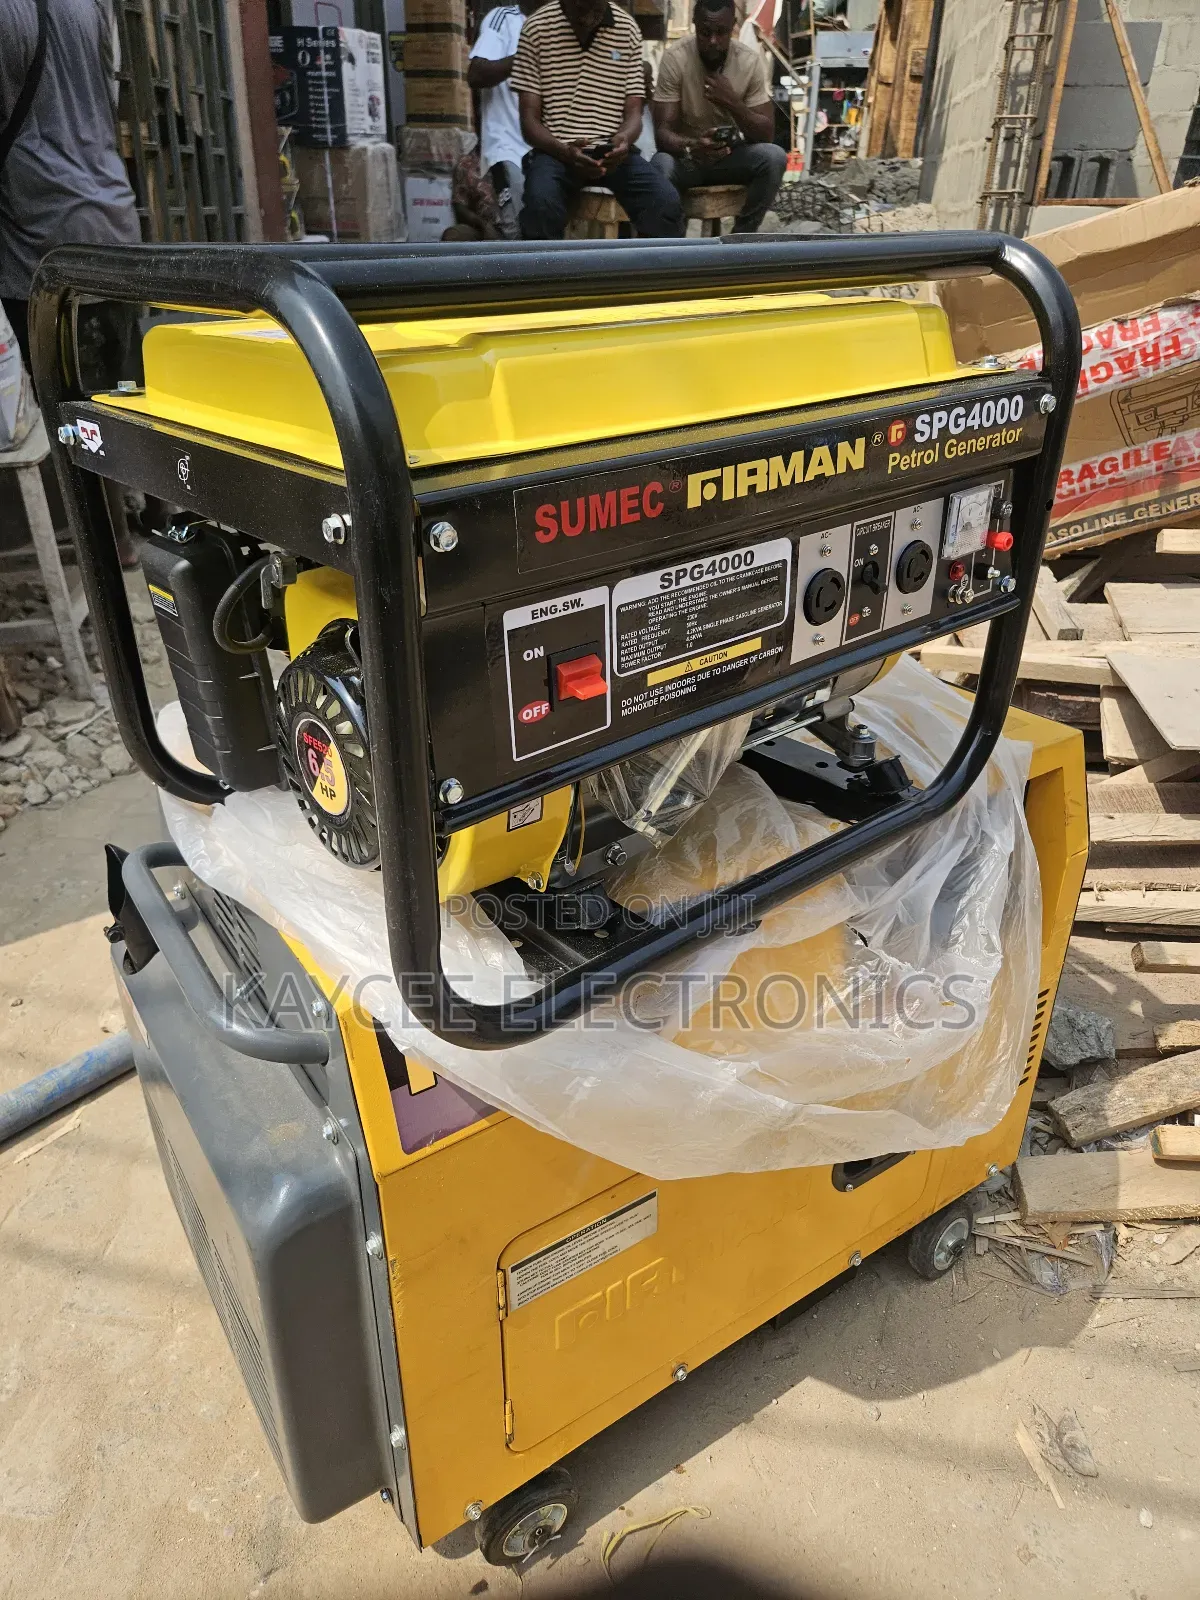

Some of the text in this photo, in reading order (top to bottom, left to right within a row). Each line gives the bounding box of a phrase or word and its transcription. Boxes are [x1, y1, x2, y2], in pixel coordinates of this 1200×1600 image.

[914, 394, 1024, 443] SPG4000
[887, 424, 1023, 475] Petrol Generator
[1057, 440, 1172, 489] RAGILE
[535, 480, 665, 545] SUMEC
[687, 437, 866, 509] FIRMAN
[856, 519, 891, 538] CIRCUIT BREAKER
[1045, 511, 1127, 543] ASOLINE
[659, 550, 756, 591] SPG4000
[854, 558, 864, 568] ON
[660, 593, 669, 601] THE
[670, 583, 709, 598] RECOMMENDED
[726, 575, 735, 583] THE
[531, 598, 584, 620] ENG.SW.
[648, 604, 659, 612] YOU
[660, 599, 676, 608] START
[648, 609, 662, 617] READ
[663, 605, 674, 613] AND
[849, 615, 860, 625] OFF
[620, 630, 637, 641] RATED
[638, 623, 660, 635] VOLTAGE
[620, 645, 636, 655] RATED
[638, 639, 658, 650] OUTPUT
[702, 620, 719, 630] SINGLE
[719, 615, 734, 624] PHASE
[620, 638, 637, 648] RATED
[641, 628, 670, 642] FREQUENCY
[523, 646, 545, 661] ON
[620, 649, 645, 663] MAXIMUM
[646, 643, 667, 654] OUTPUT
[620, 658, 640, 670] POWER
[641, 651, 661, 663] FACTOR
[699, 651, 728, 666] CAUTION
[621, 646, 784, 708] DO NOT USE INDOORS DUE TO DANGER OF CARBON
[522, 703, 550, 721] OFF
[621, 684, 697, 718] MONOXIDE POISONING
[303, 732, 333, 758] SFE520
[307, 748, 336, 787] 6.5
[319, 781, 337, 801] HP
[565, 1218, 607, 1243] OPERATION
[555, 1256, 677, 1350] FIR
